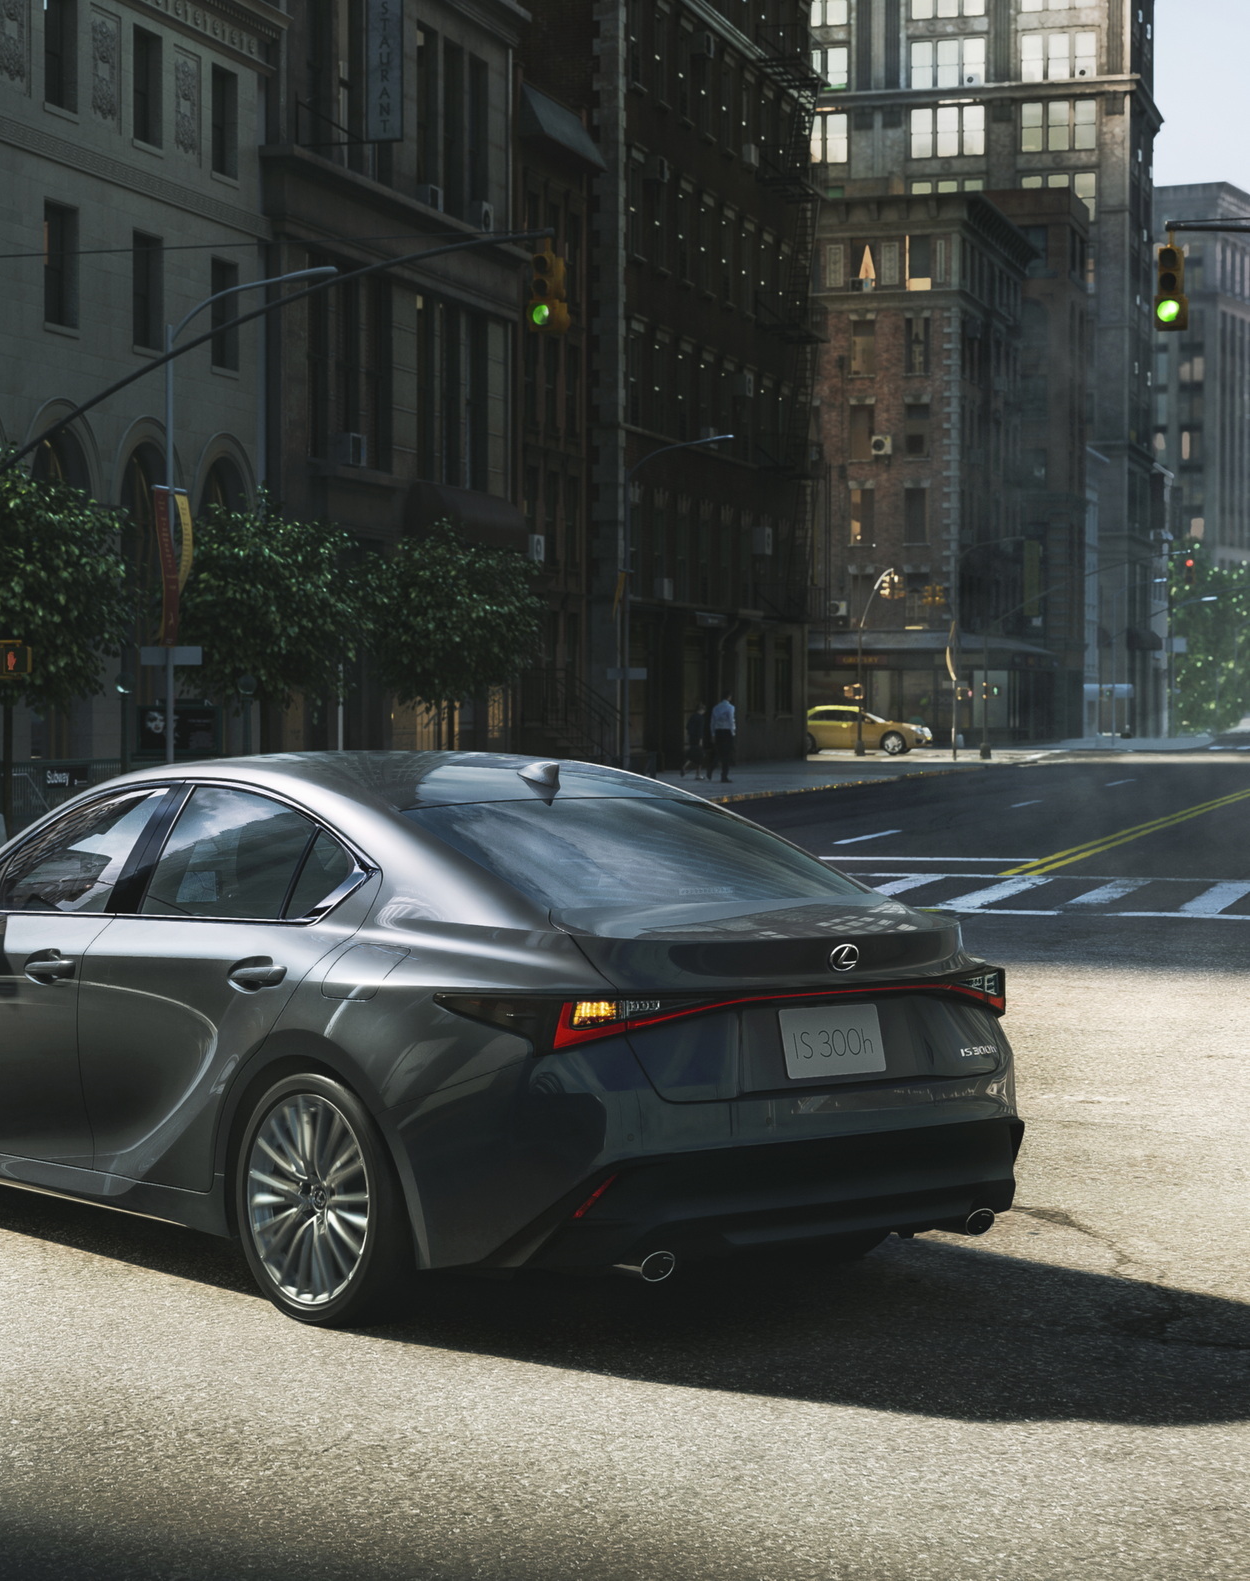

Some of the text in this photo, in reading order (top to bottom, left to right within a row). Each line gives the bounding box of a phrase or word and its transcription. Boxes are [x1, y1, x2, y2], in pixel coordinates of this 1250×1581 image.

[46, 770, 70, 787] Subway
[792, 1027, 874, 1060] IS 300h
[960, 1048, 972, 1057] IS
